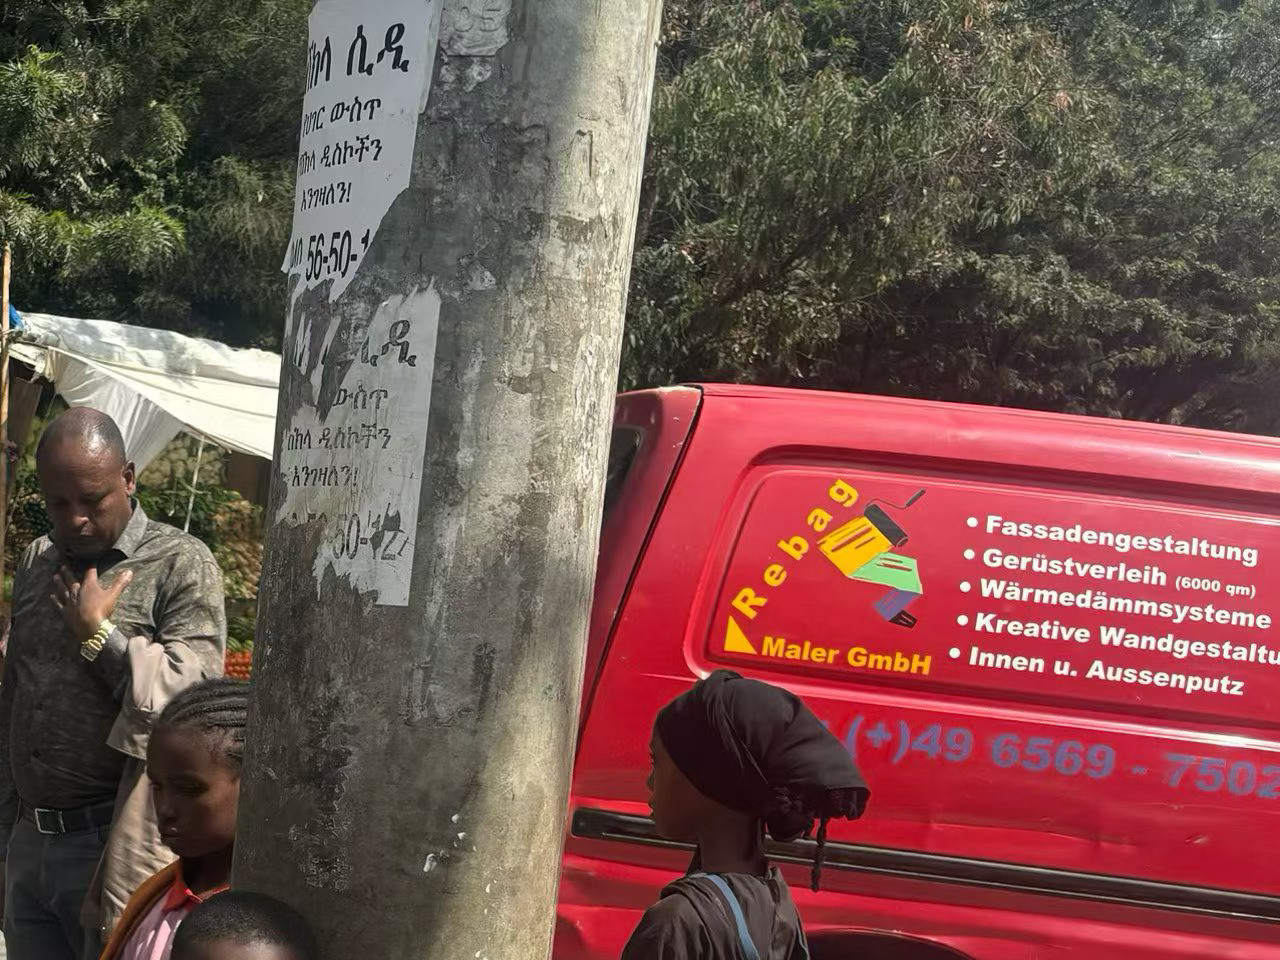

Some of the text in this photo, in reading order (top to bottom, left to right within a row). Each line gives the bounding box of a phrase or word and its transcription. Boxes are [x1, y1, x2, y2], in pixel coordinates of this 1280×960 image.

[346, 22, 410, 76] ሲዲ
[329, 95, 382, 123] ውስጥ
[730, 478, 860, 621] Rebag
[985, 515, 1259, 567] Fassadengestaltung
[982, 548, 1257, 600] Gerüstverleih (6000 qm)
[980, 577, 1272, 630] Wärmedämmsysteme
[761, 635, 933, 676] Maler GmbH
[974, 612, 1280, 666] Kreative Wandgestaltu
[969, 646, 1246, 696] Innen u. Aussenputz
[991, 732, 1117, 779] 6569
